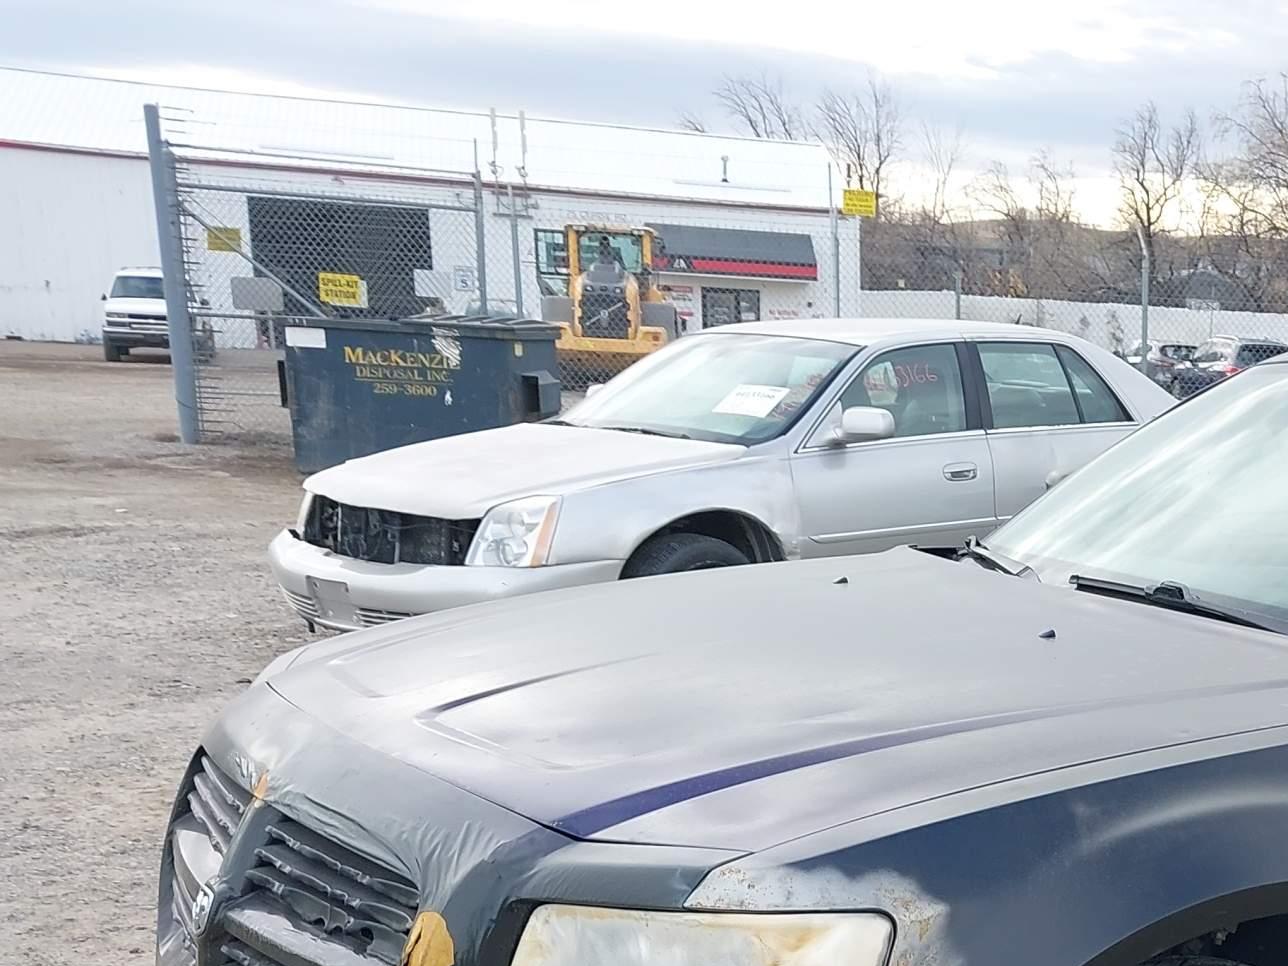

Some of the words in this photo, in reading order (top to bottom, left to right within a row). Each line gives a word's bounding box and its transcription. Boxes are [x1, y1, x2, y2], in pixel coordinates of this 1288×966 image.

[356, 366, 423, 381] DISPOSAL
[426, 369, 454, 382] INC.
[373, 382, 437, 396] 259-3600
